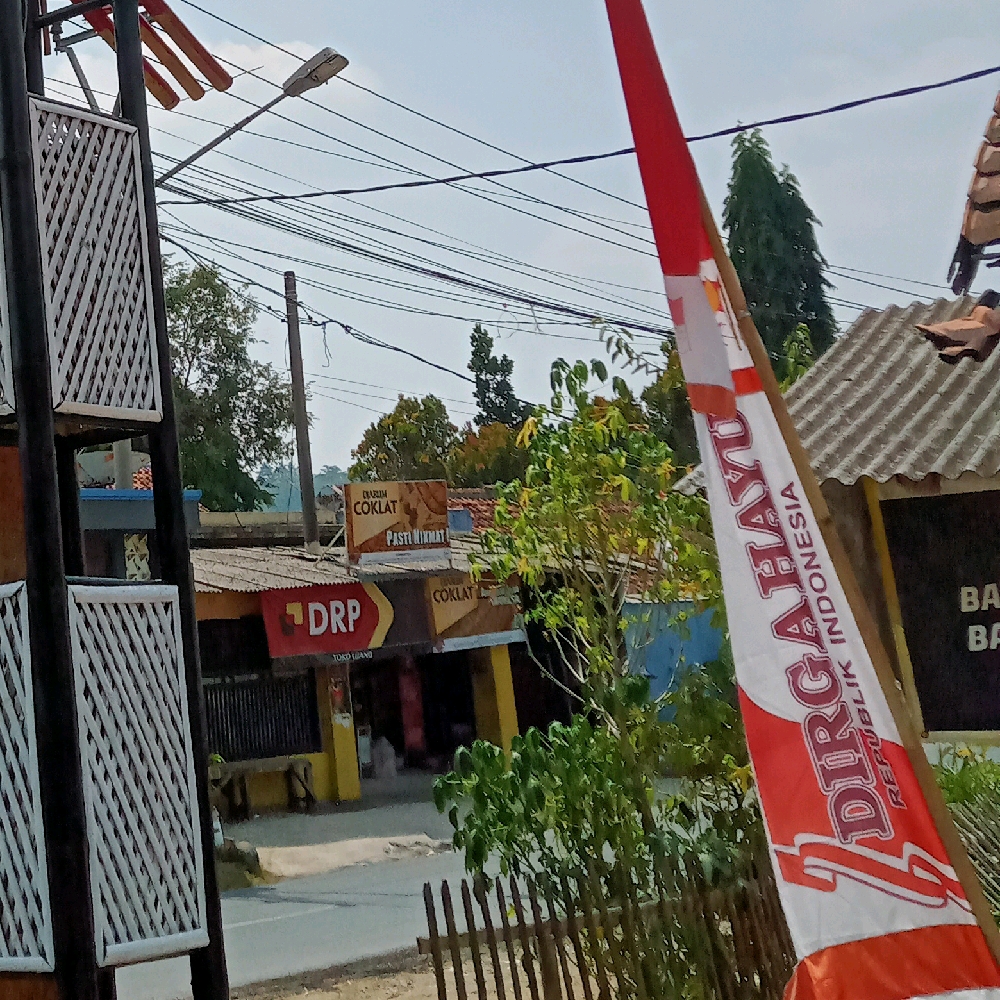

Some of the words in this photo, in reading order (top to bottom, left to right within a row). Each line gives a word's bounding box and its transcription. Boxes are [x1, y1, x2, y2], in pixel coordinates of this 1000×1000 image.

[353, 499, 398, 516] COKLAT
[432, 585, 475, 604] COKLAT
[780, 480, 847, 646] INDONESIA
[307, 598, 361, 637] DRP
[706, 409, 896, 844] DIRGAHAYU
[836, 659, 907, 811] REPUBLIK
